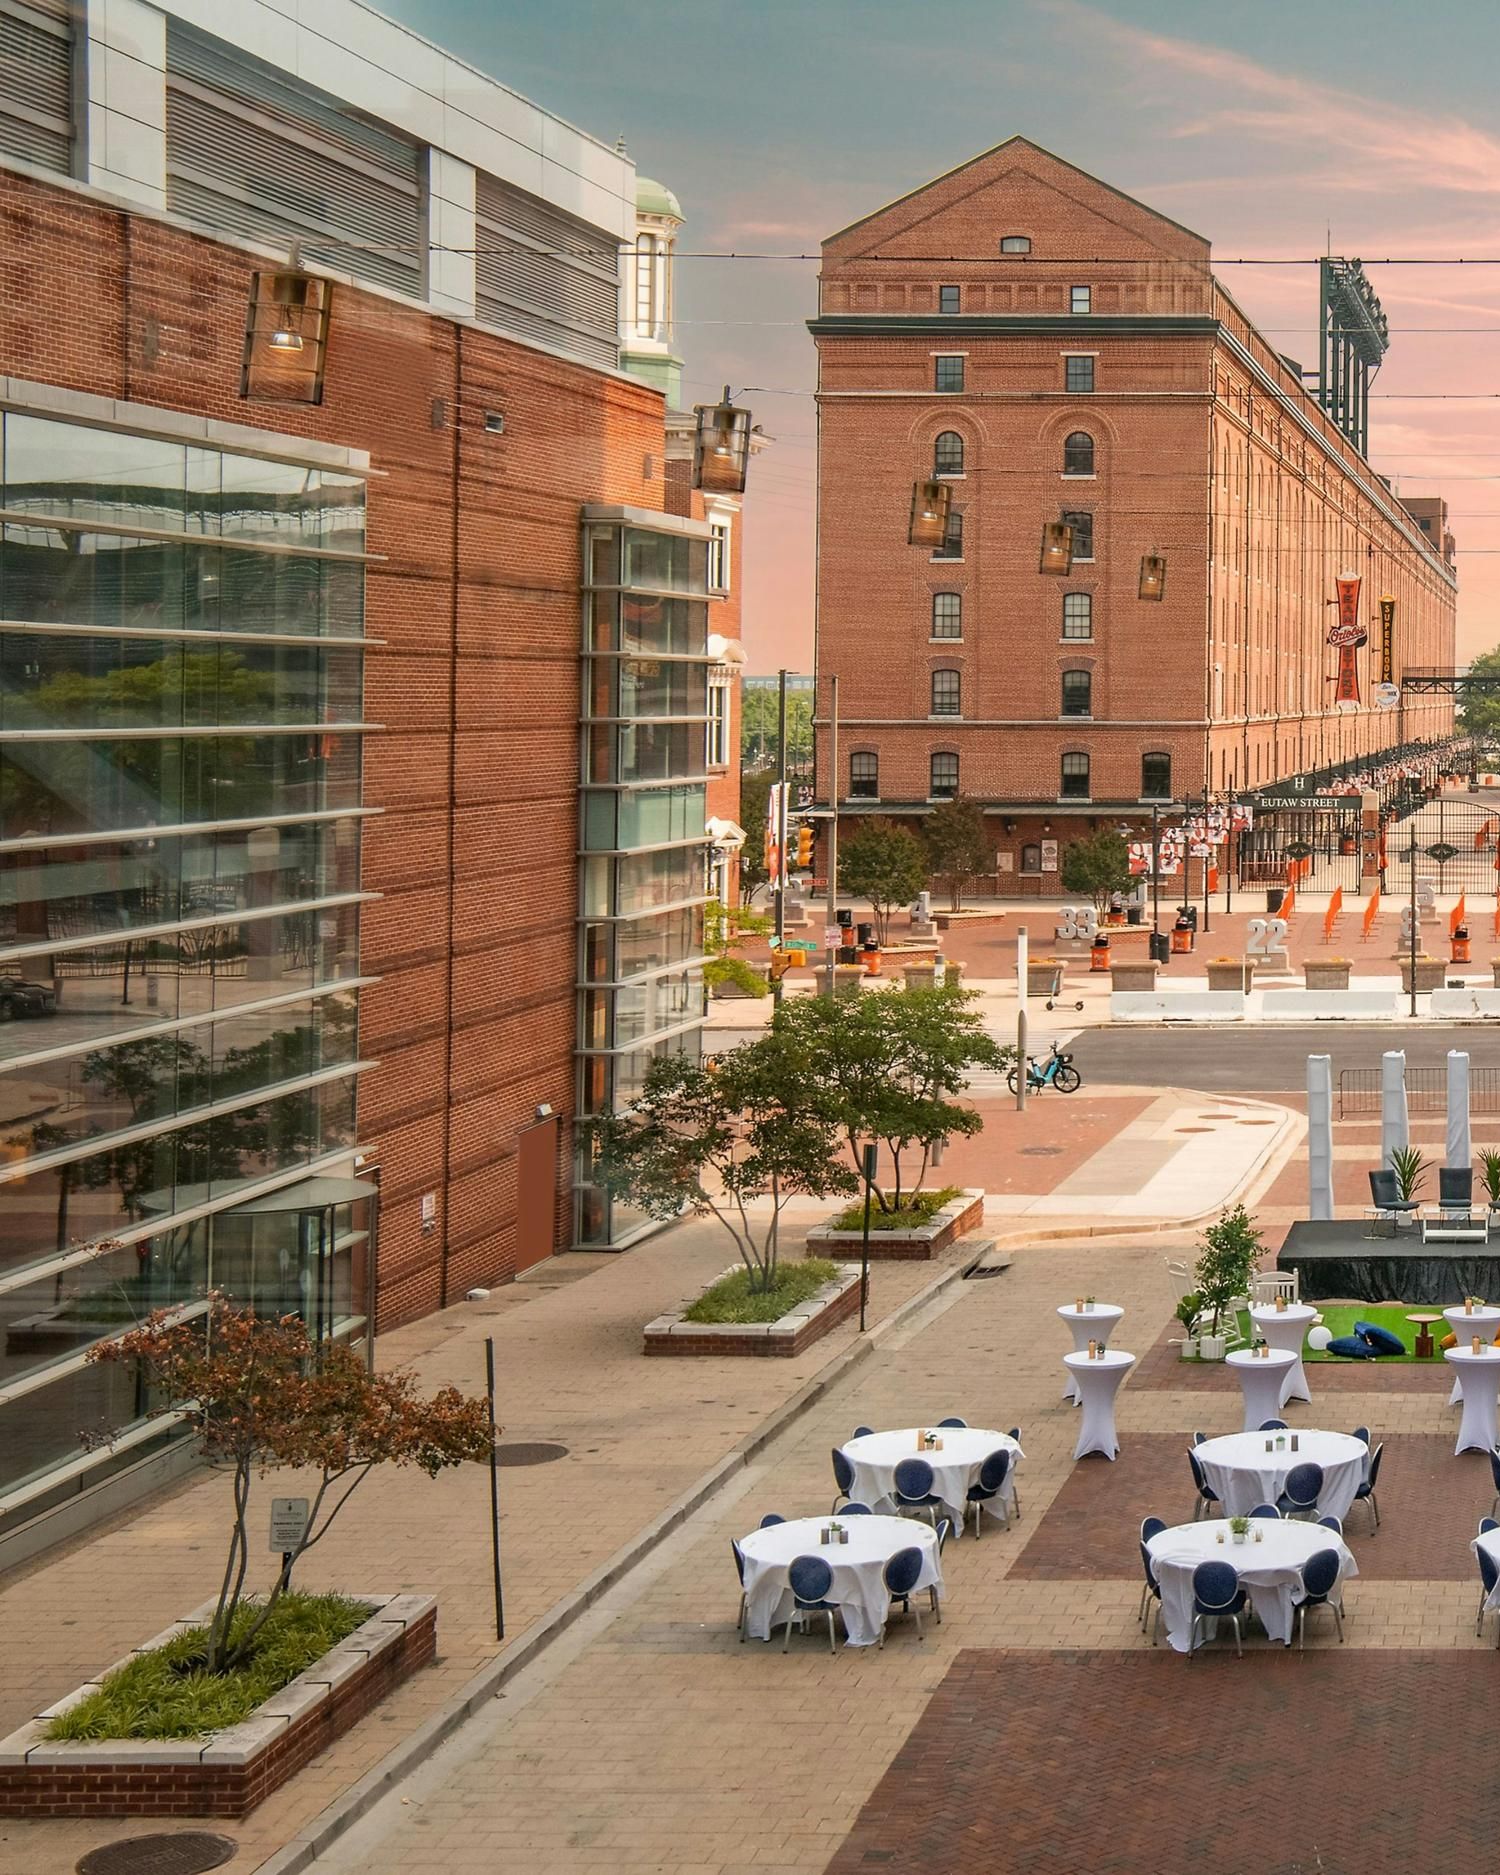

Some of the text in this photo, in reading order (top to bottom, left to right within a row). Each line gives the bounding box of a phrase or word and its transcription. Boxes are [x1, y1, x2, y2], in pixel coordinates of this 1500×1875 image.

[1330, 627, 1366, 643] Orioles
[1383, 605, 1391, 681] SUPERBOOK
[1261, 798, 1340, 807] EUTAW STREET
[1058, 906, 1097, 940] 33
[1247, 920, 1288, 954] 22
